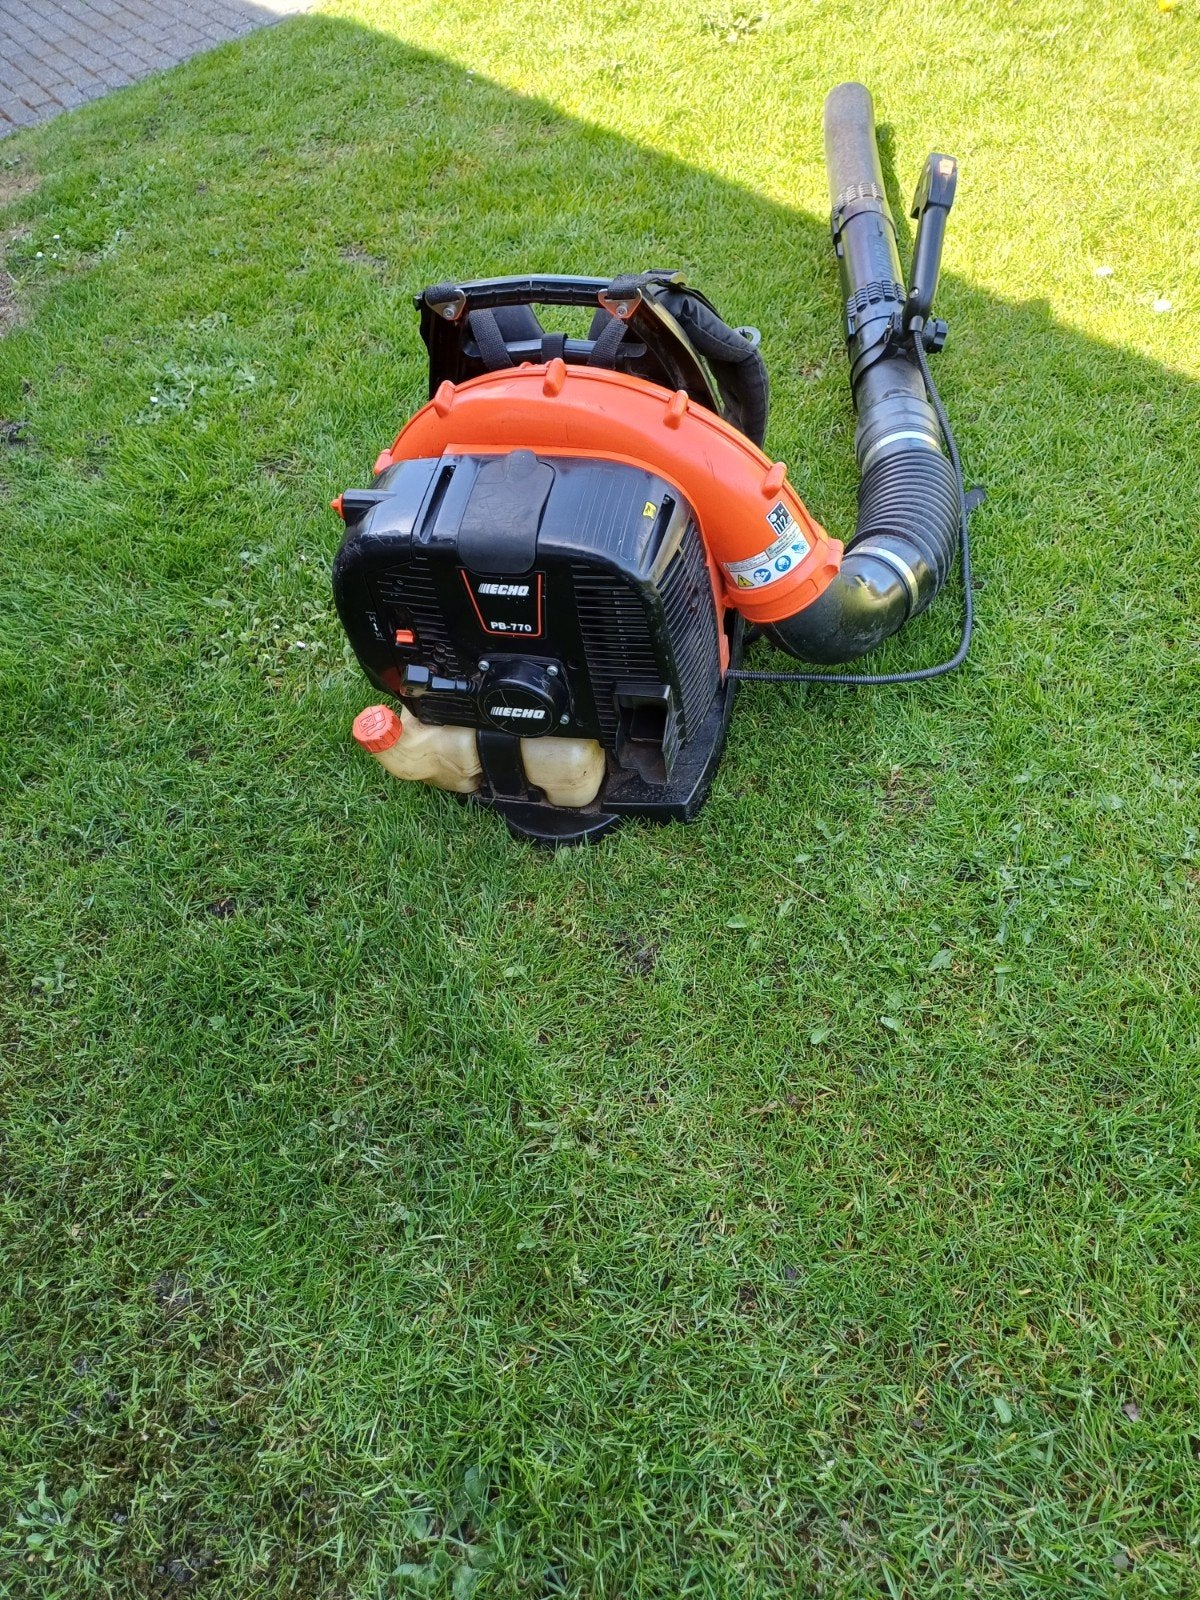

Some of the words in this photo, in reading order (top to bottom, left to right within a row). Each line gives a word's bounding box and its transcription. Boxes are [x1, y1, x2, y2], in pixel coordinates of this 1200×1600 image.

[488, 583, 530, 596] ECHO
[490, 621, 532, 632] PB-770
[502, 706, 546, 720] ECHO
